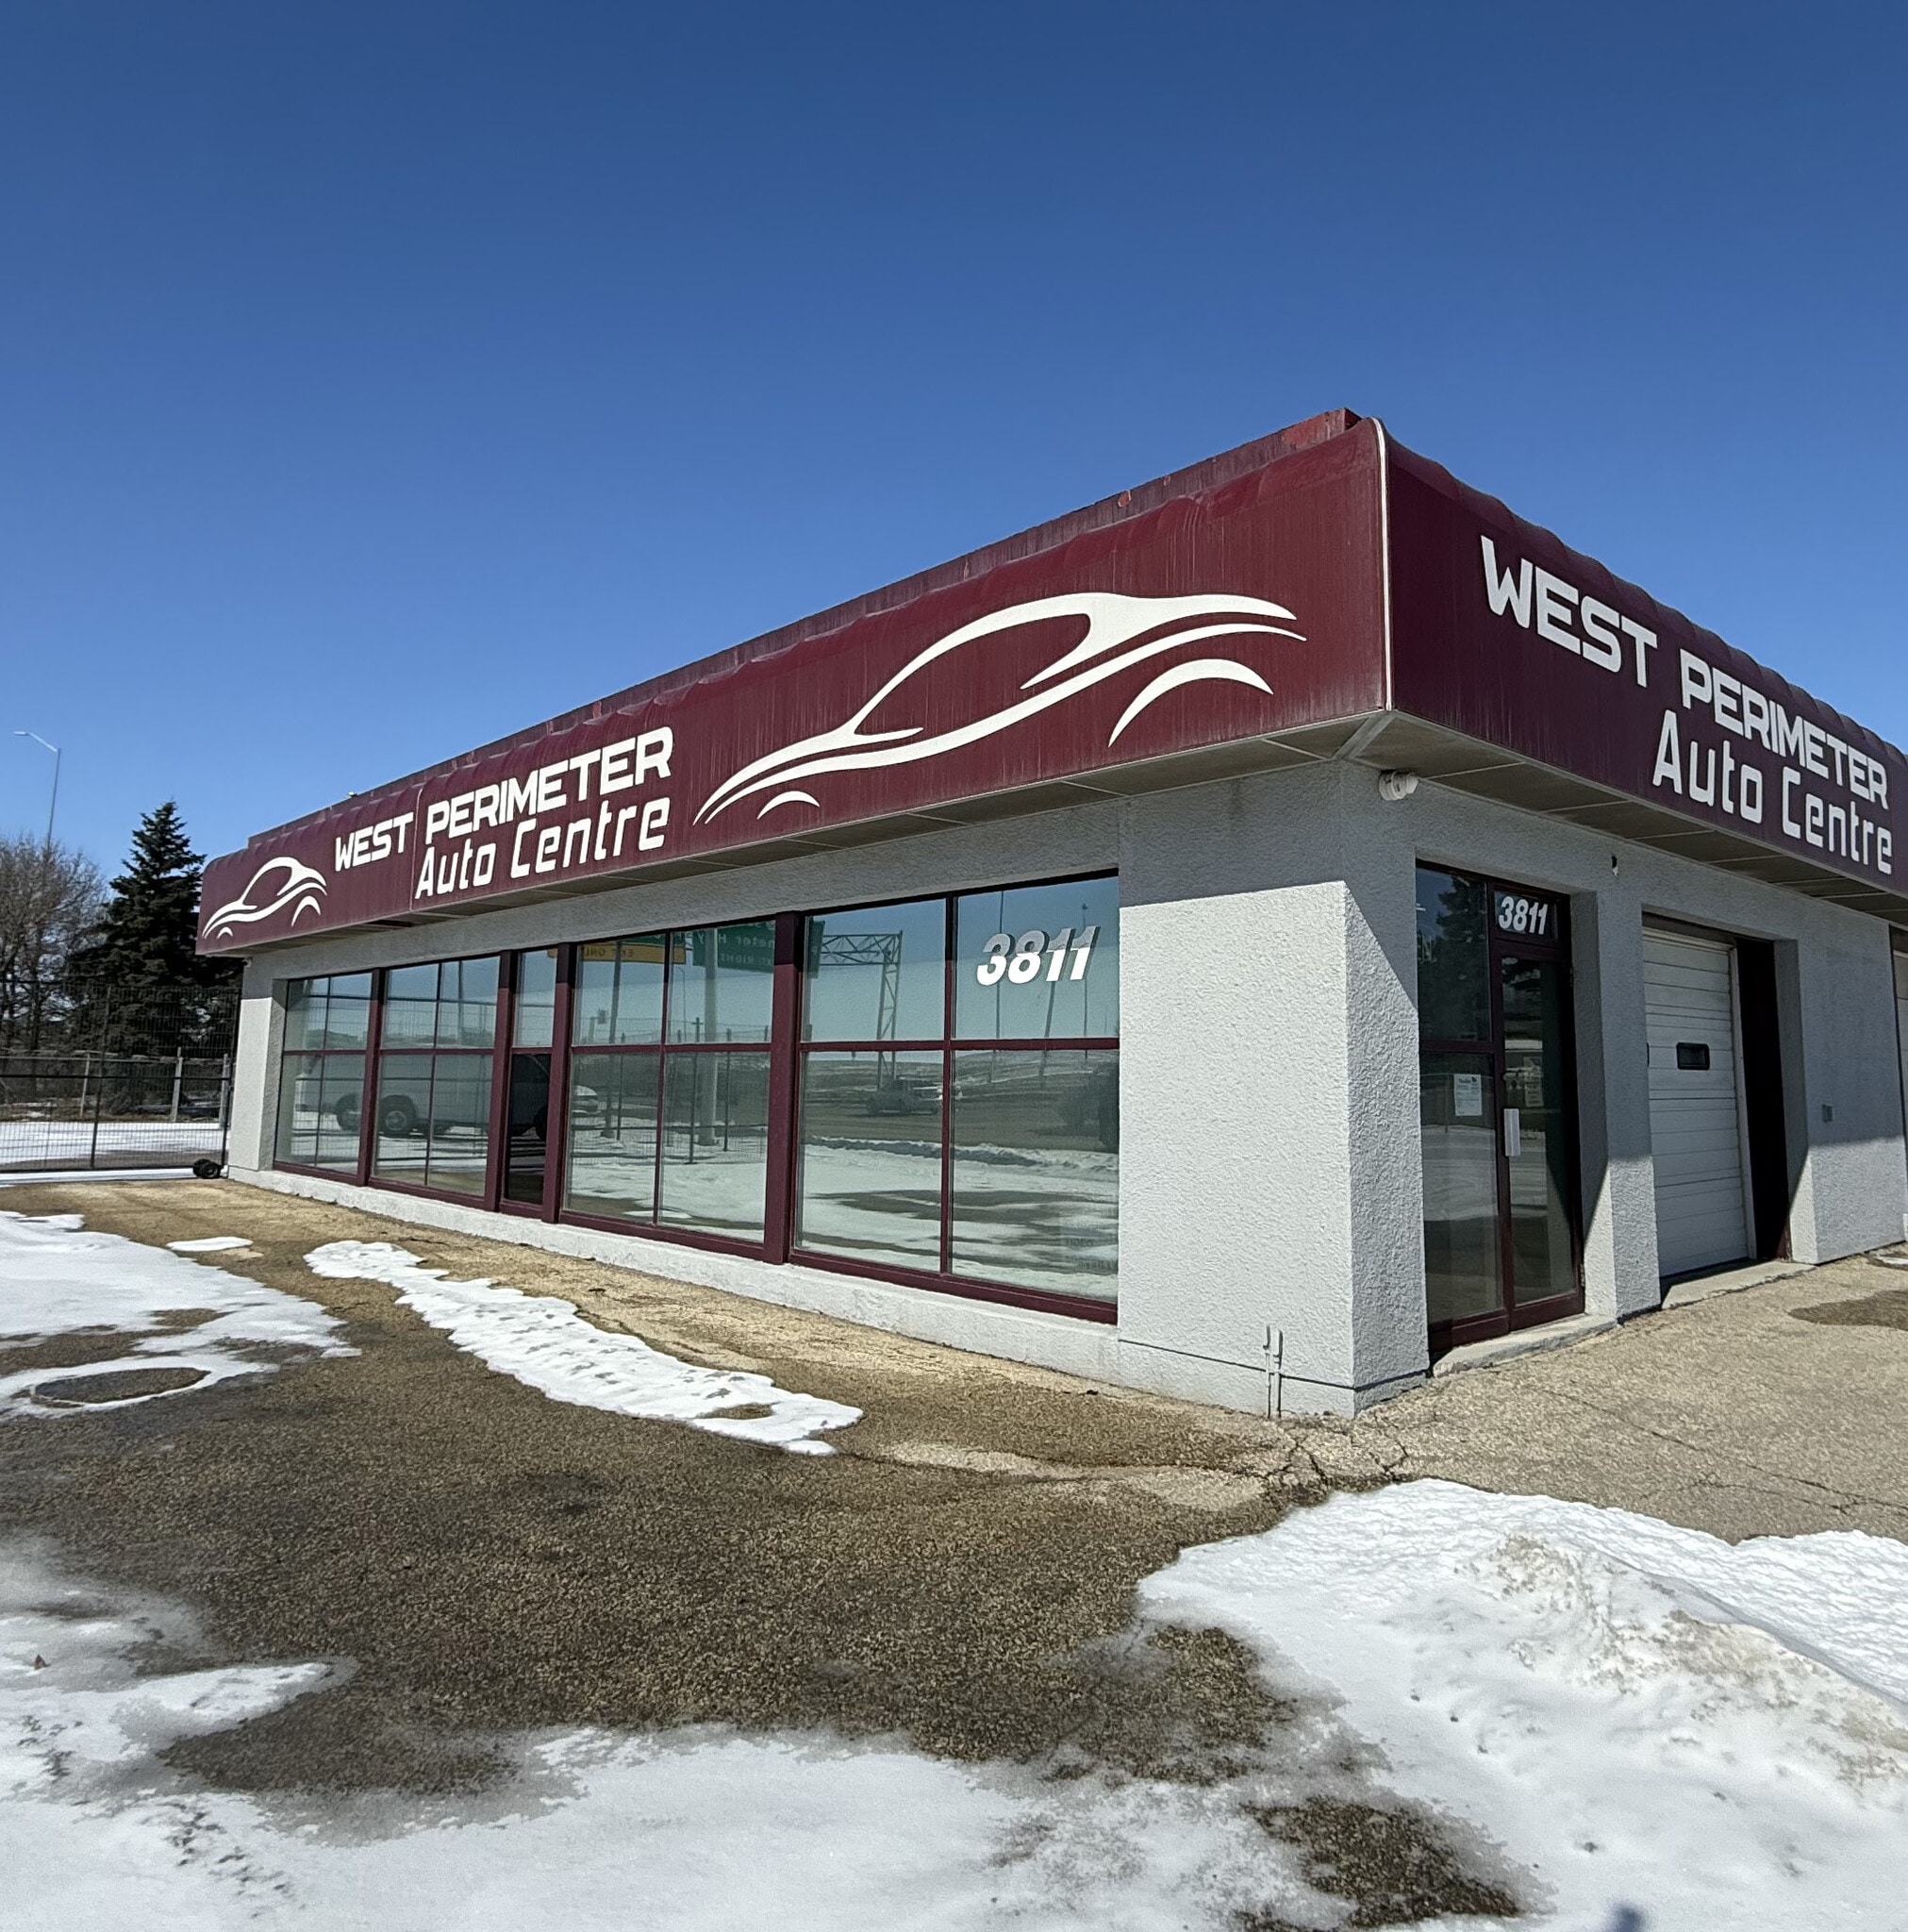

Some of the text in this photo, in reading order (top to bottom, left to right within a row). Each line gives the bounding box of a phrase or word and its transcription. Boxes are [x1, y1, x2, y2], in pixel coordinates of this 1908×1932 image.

[1481, 536, 1889, 809] WEST PERIMETER
[335, 726, 673, 872] WEST PERIMETER
[415, 798, 671, 899] Auto Centre
[1653, 710, 1892, 874] Auto Centre
[977, 926, 1100, 986] 3811
[1499, 896, 1548, 935] 3811
